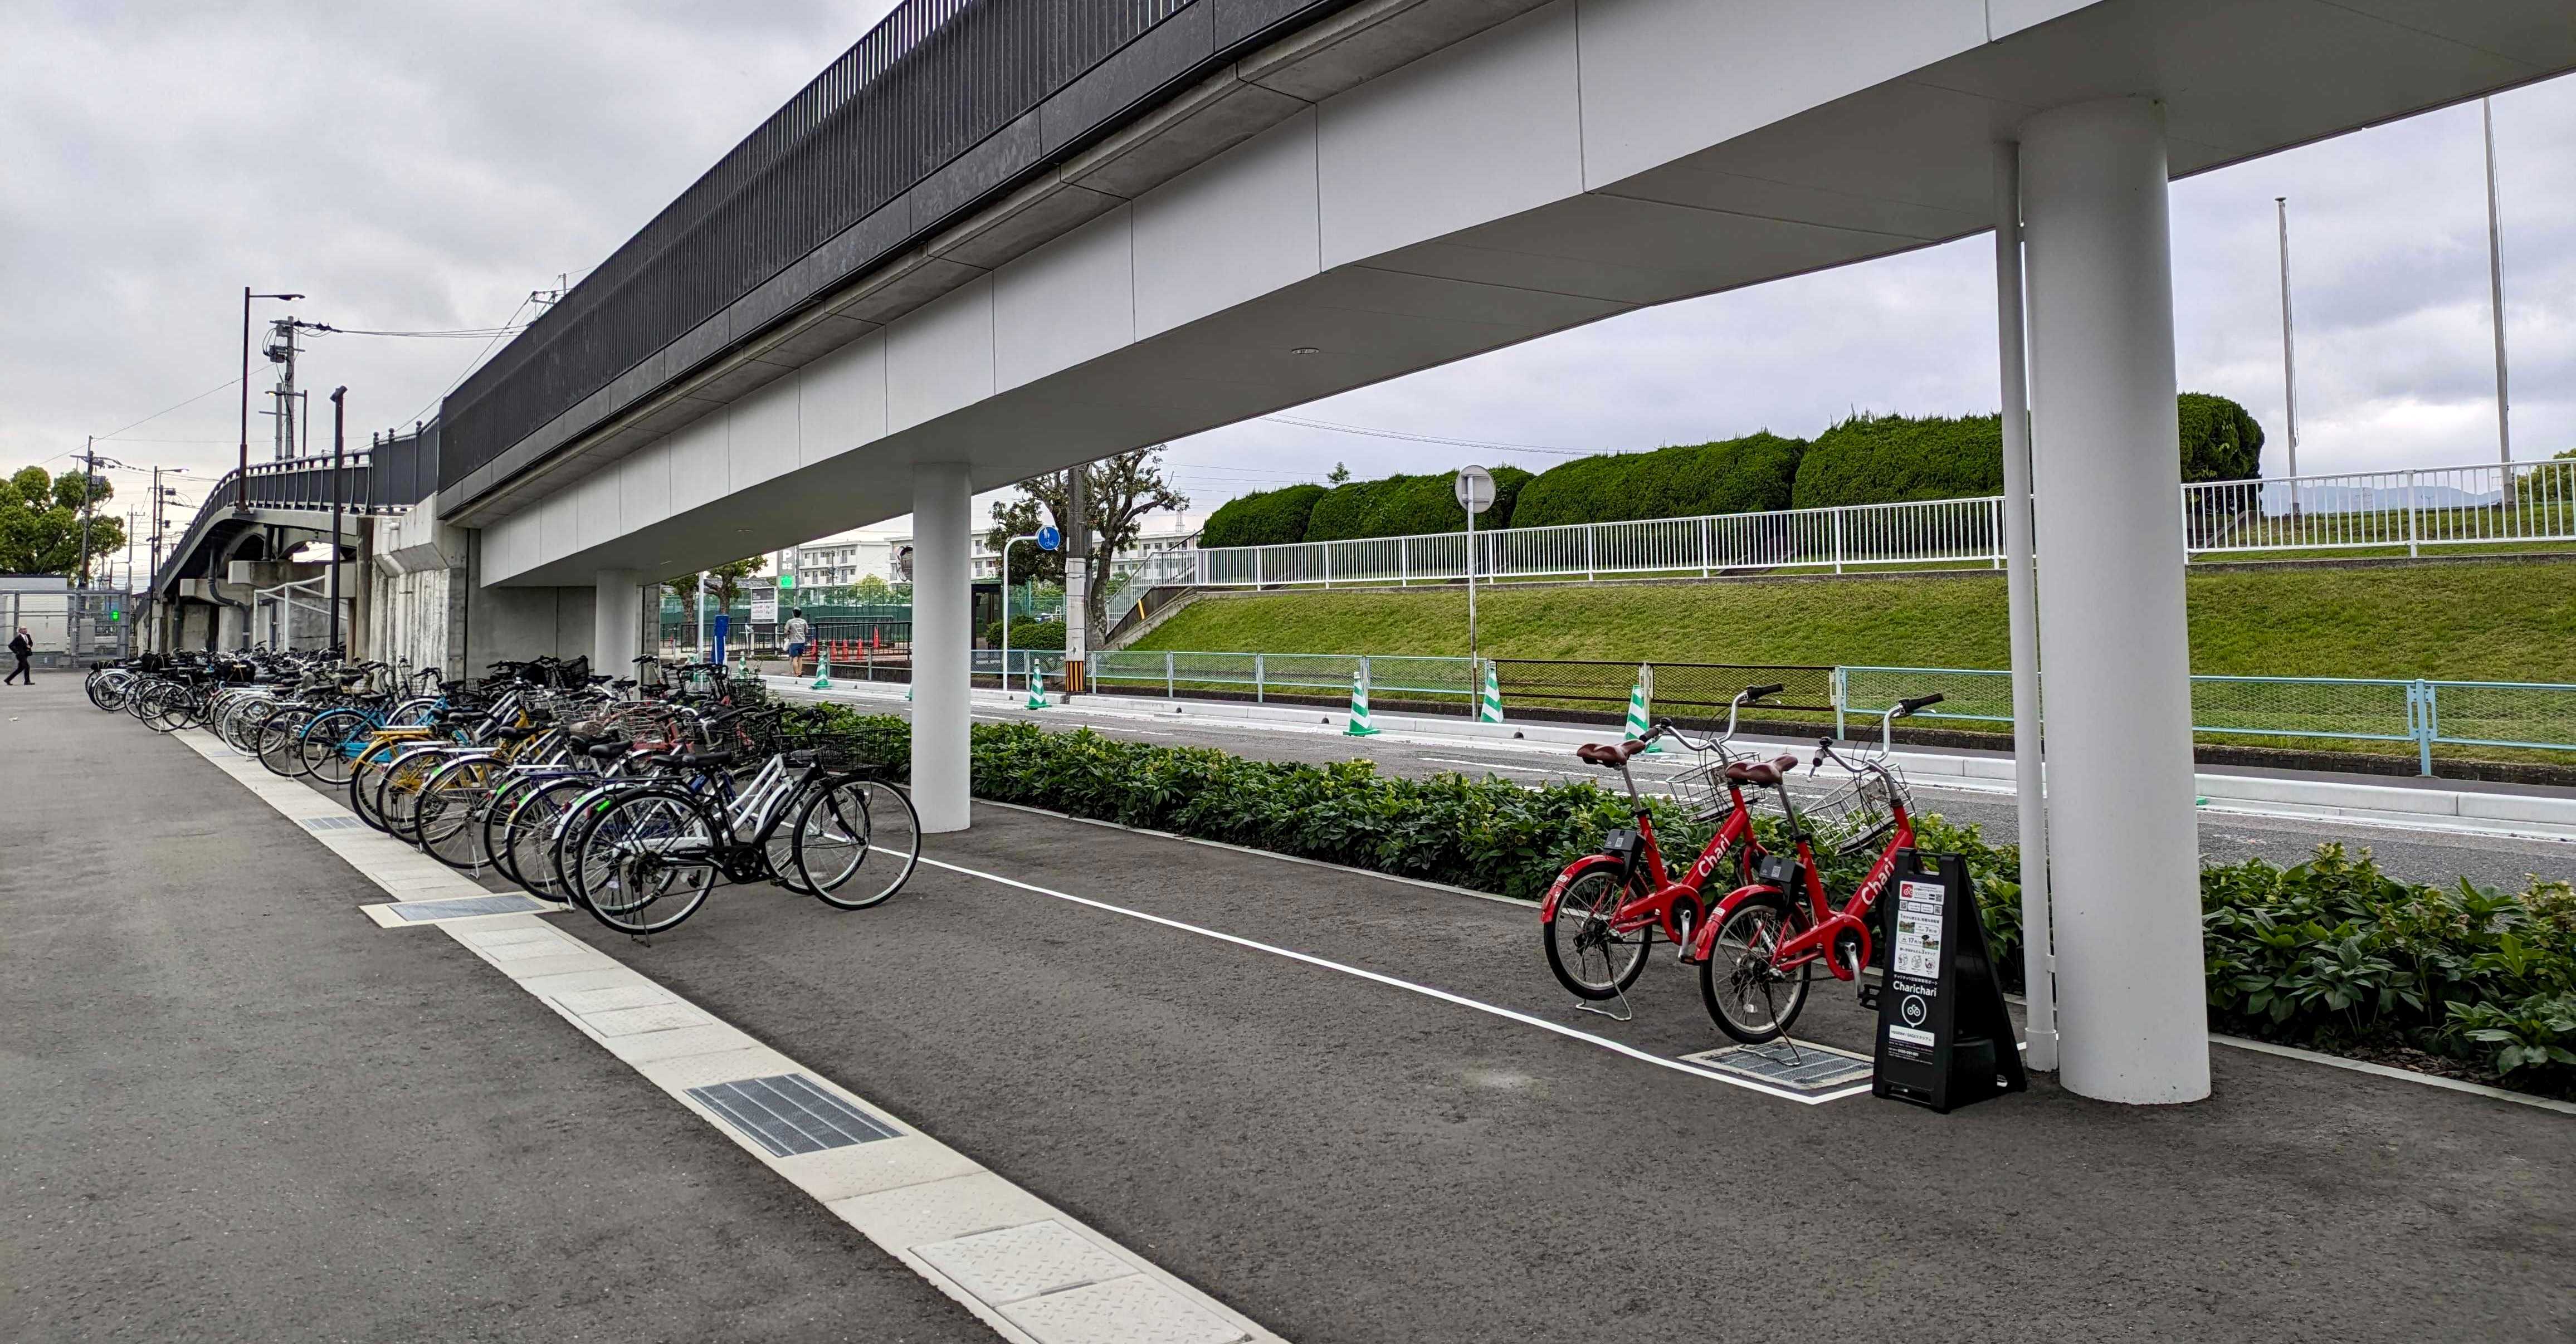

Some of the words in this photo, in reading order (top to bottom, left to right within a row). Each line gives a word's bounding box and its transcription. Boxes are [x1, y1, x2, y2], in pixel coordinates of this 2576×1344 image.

[783, 550, 792, 561] P
[1698, 833, 1730, 877] Chari
[1861, 857, 1895, 905] Chari
[1893, 980, 1937, 997] Charichari
